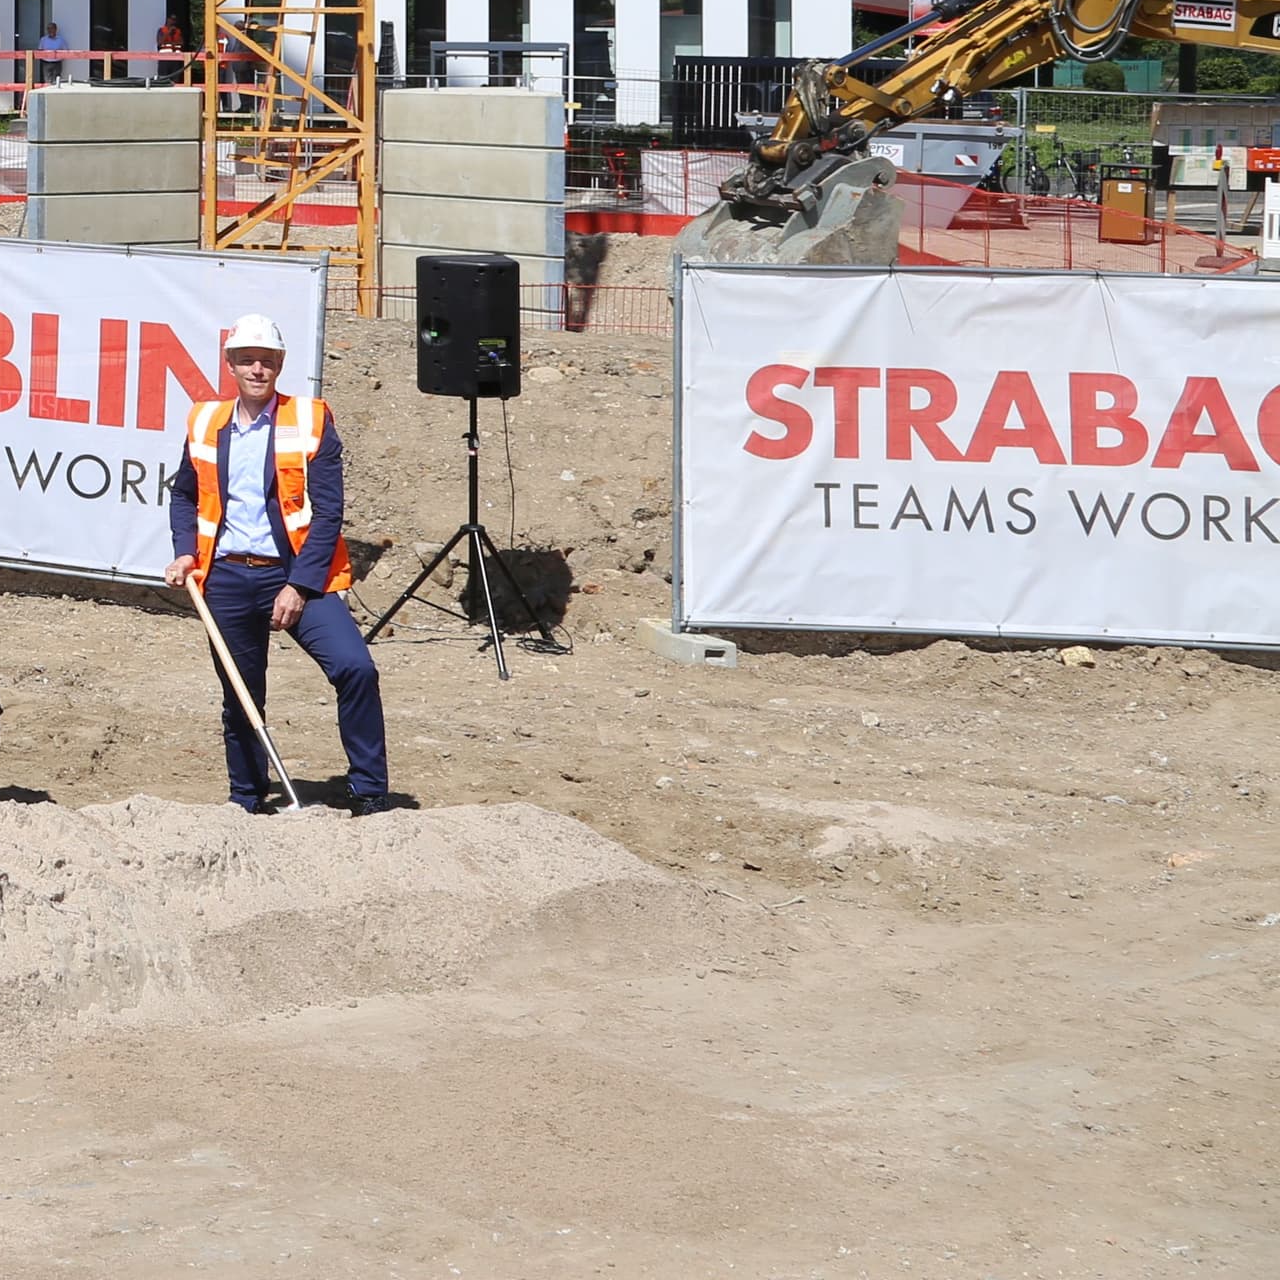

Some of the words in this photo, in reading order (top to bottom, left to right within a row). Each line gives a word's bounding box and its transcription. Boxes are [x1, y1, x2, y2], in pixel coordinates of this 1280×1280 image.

[1174, 4, 1233, 21] STRABAG
[744, 363, 1280, 472] STRABA
[814, 482, 1037, 536] TEAMS
[1068, 489, 1280, 544] WORK
